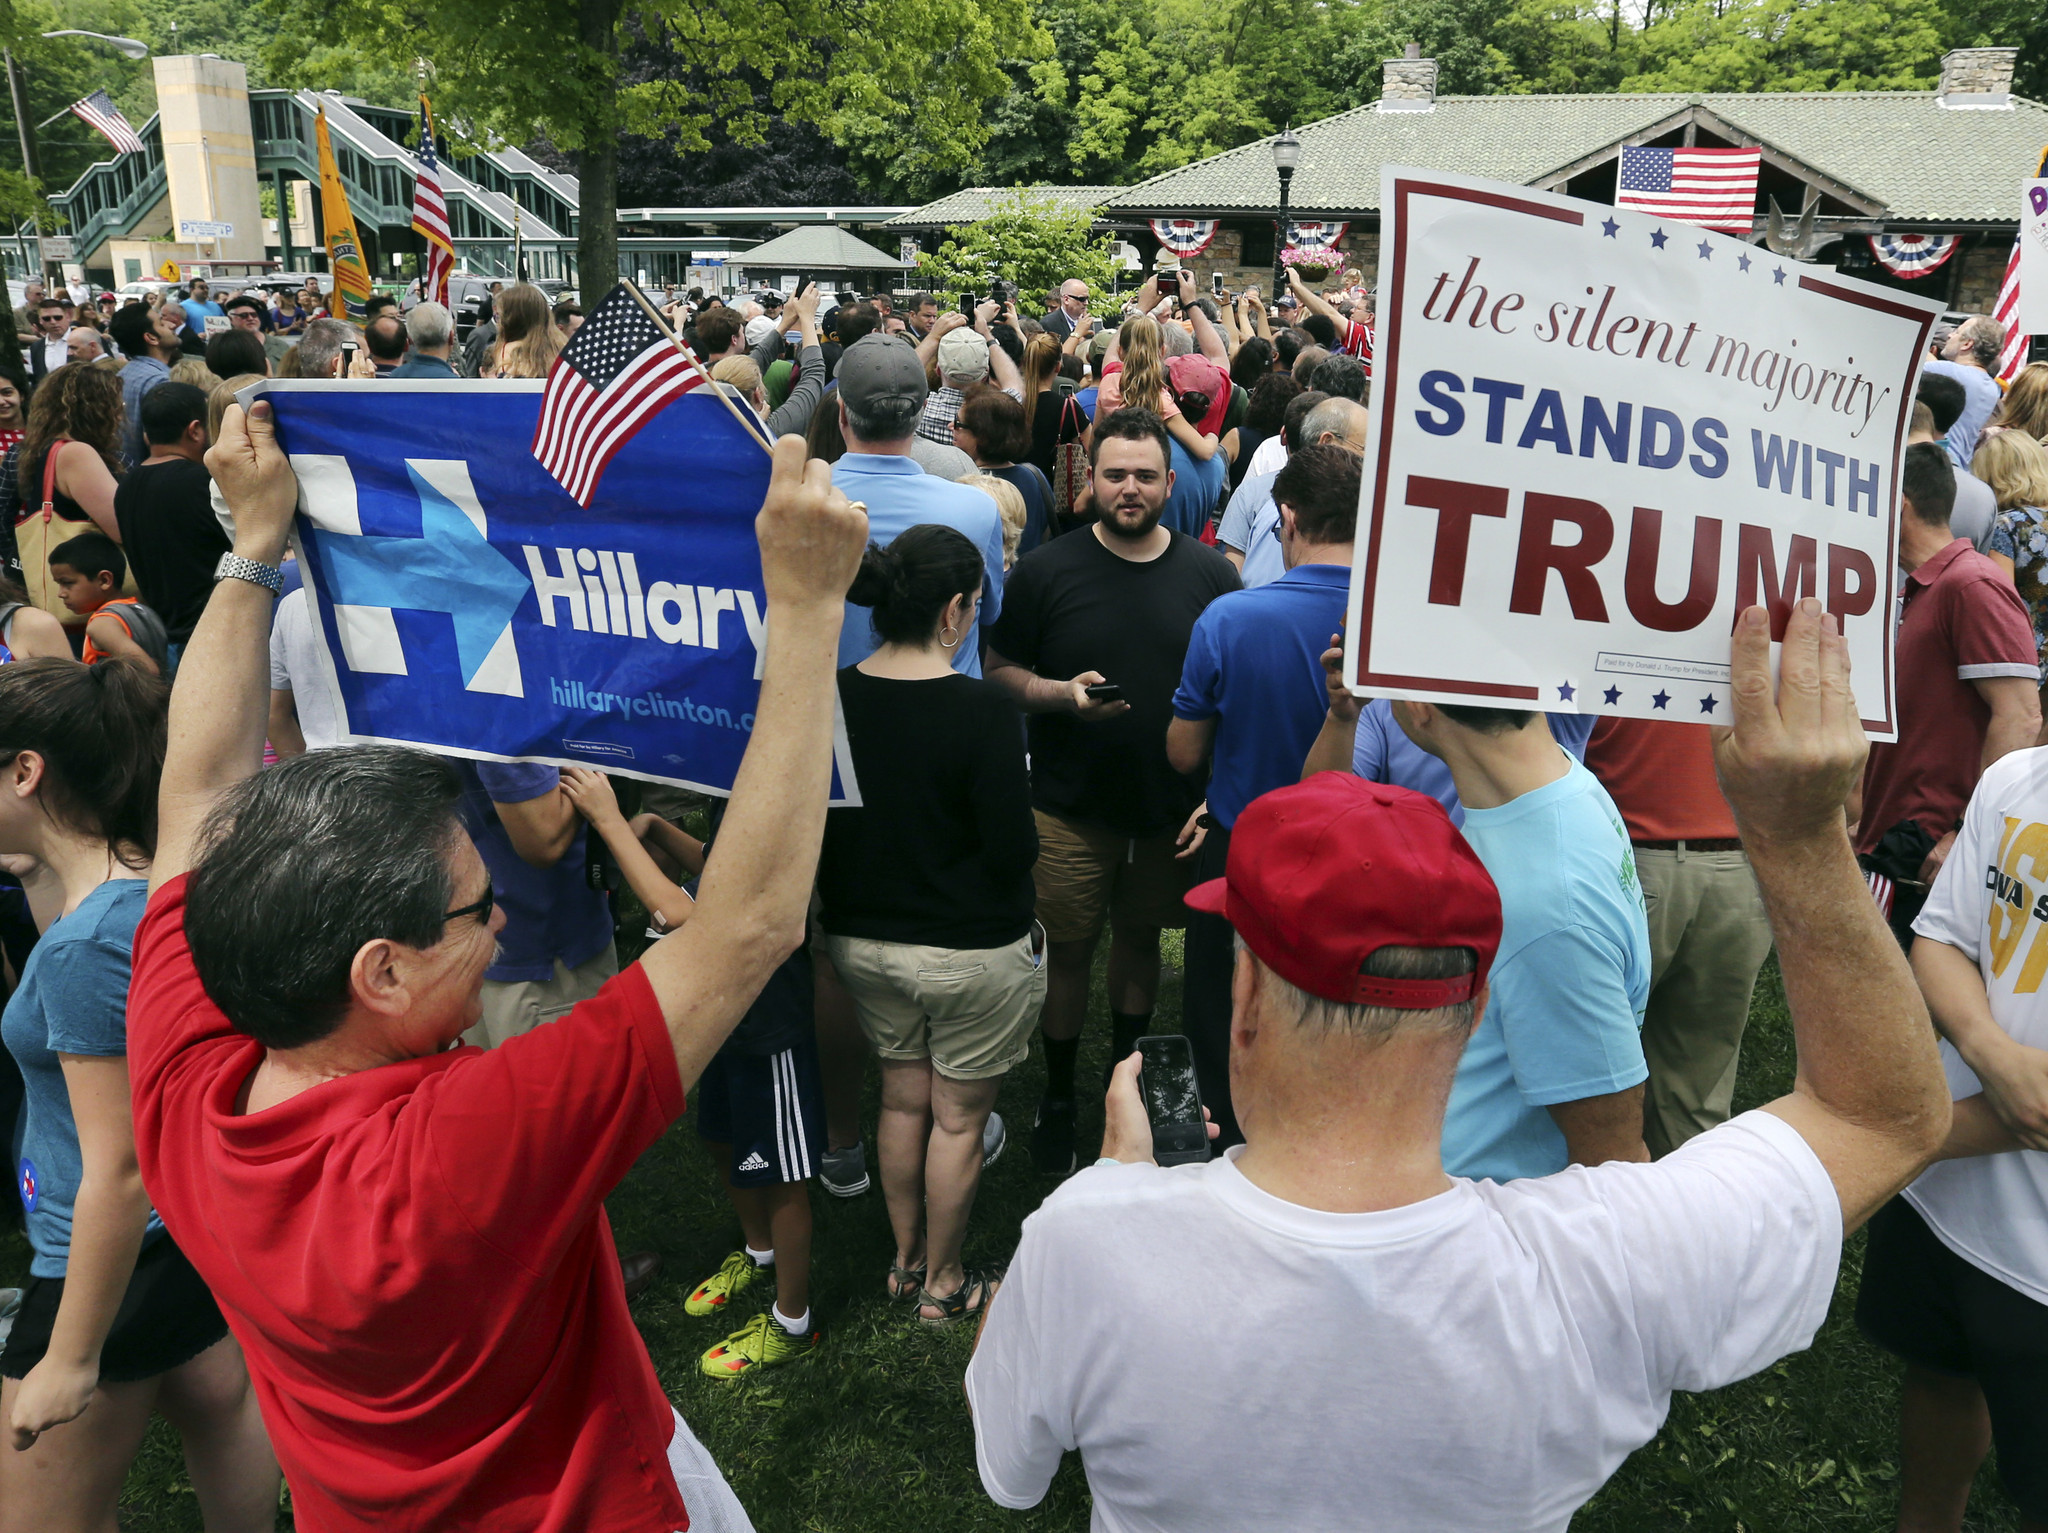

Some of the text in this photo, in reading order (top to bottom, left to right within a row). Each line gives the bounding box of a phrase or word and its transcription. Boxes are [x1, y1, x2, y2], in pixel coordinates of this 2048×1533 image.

[1422, 255, 1891, 439] the silent majority
[1414, 369, 1880, 518] STANDS WITH
[522, 544, 768, 681] Hillary
[1404, 474, 1877, 643] TRUMP
[550, 676, 756, 733] hillaryclinton.c
[1604, 658, 1617, 667] Paid
[1618, 659, 1626, 667] for
[1627, 661, 1634, 670] by
[1635, 661, 1657, 671] Donald
[1664, 664, 1682, 673] Trump
[1683, 666, 1691, 674] for
[738, 1161, 769, 1171] adidas
